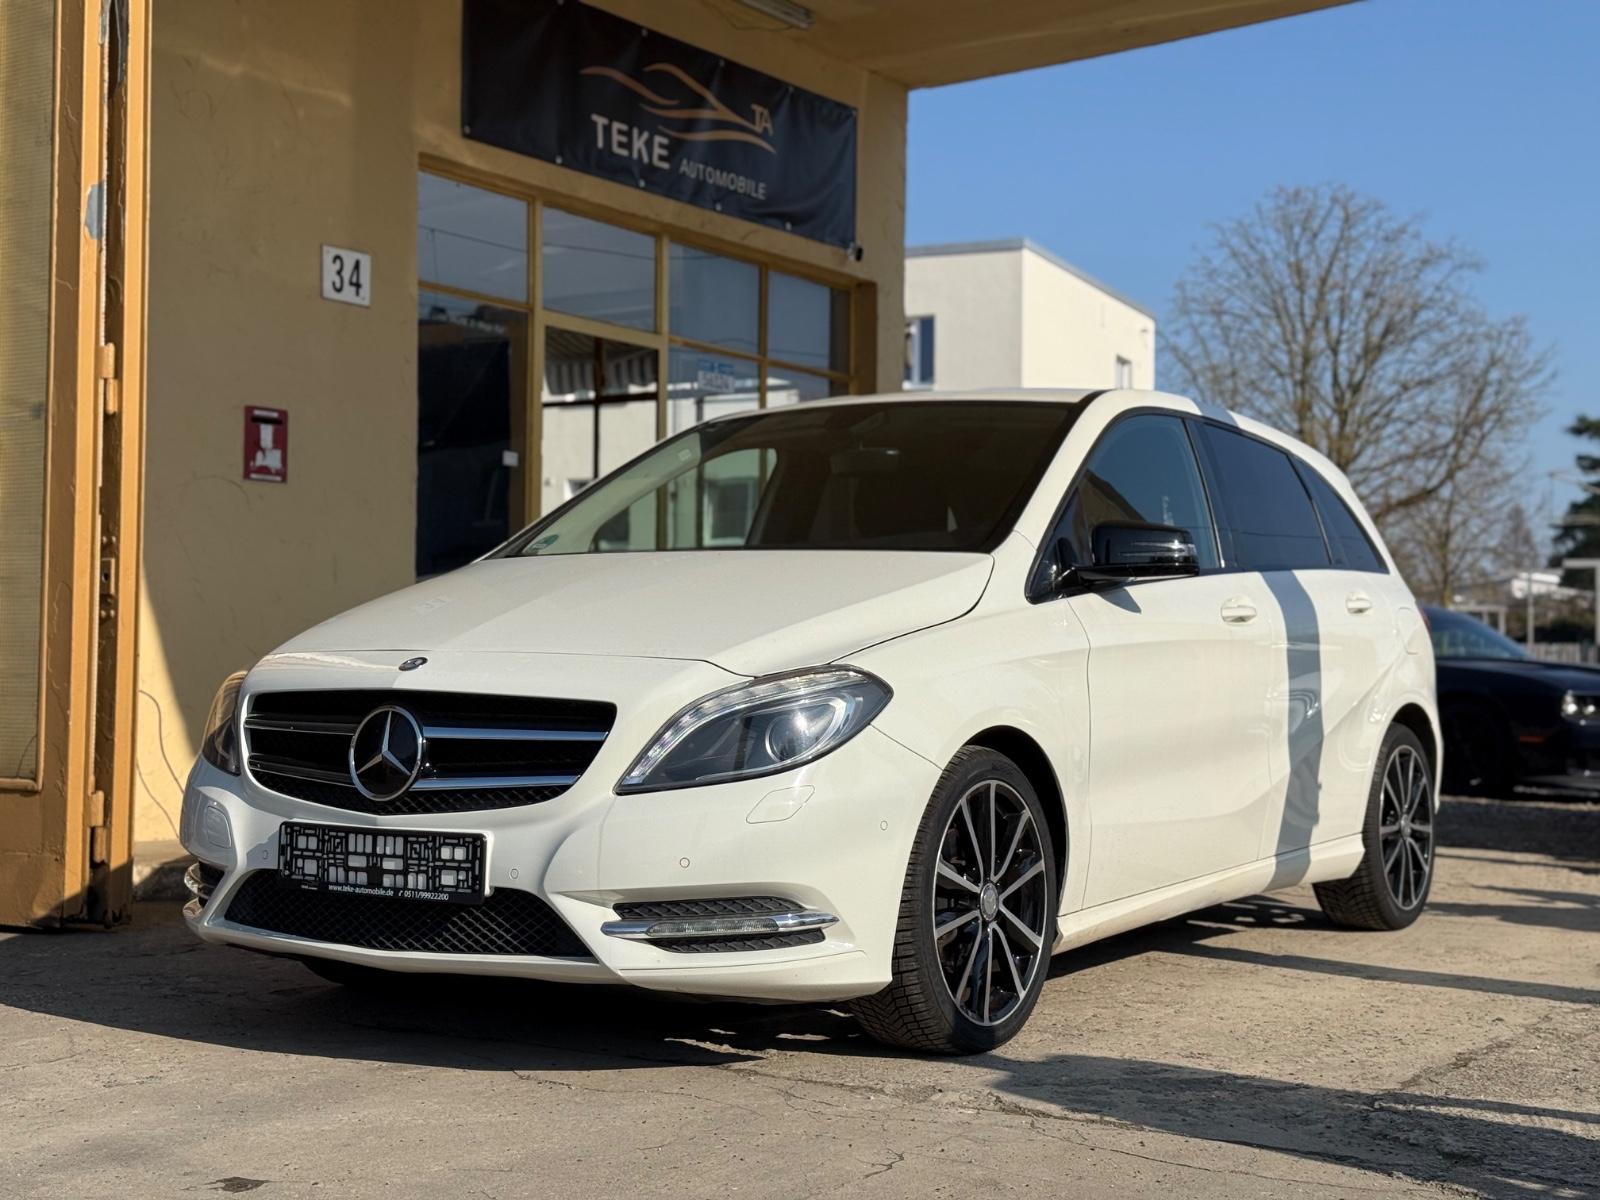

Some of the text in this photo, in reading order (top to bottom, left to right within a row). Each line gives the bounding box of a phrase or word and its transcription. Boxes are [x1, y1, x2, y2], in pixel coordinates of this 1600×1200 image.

[590, 113, 767, 200] TEKE AUTOMOBILE
[332, 254, 362, 297] 34
[328, 884, 394, 897] www.teke-automobile.de
[404, 890, 449, 901] 0511/99922200
